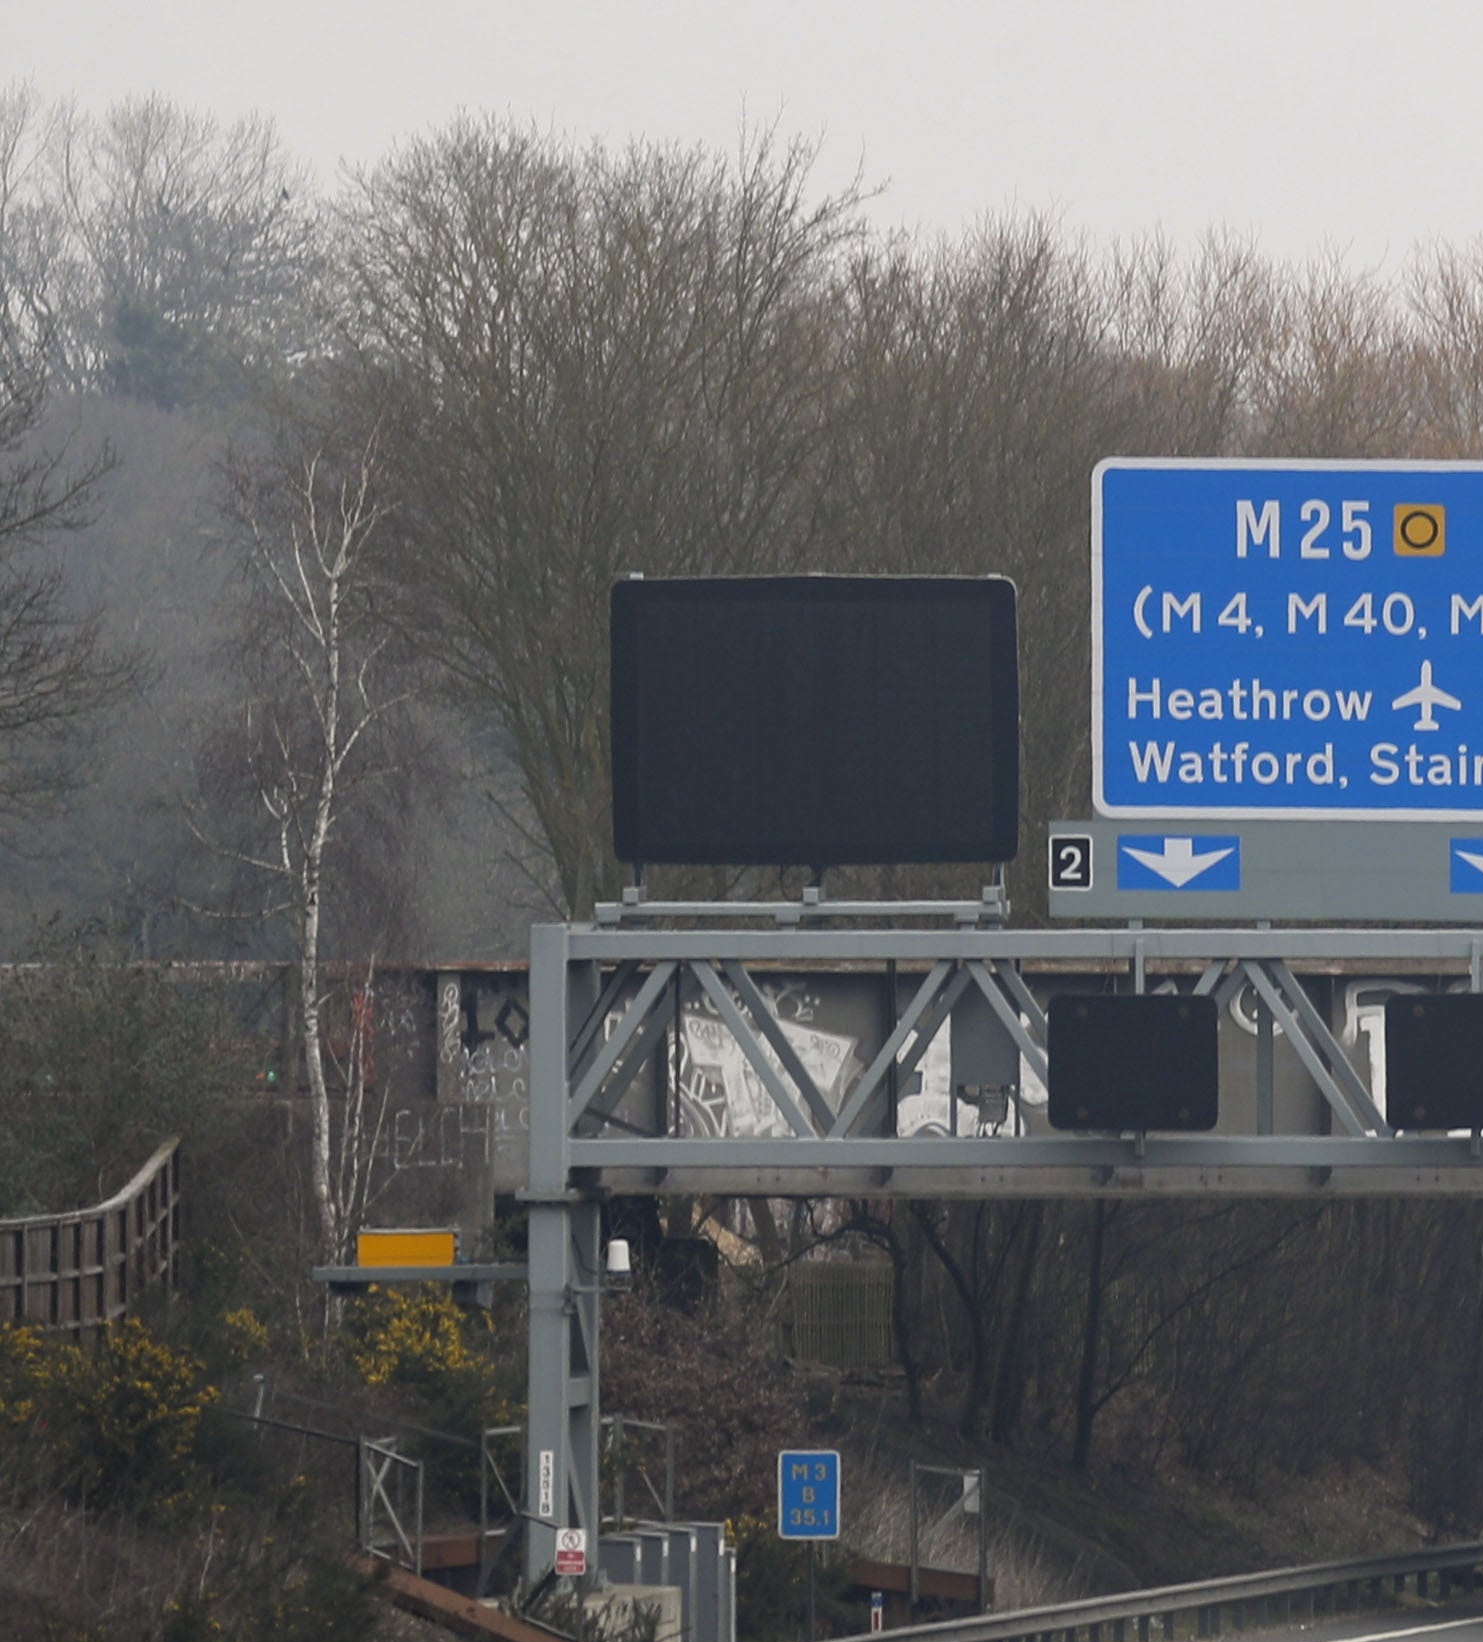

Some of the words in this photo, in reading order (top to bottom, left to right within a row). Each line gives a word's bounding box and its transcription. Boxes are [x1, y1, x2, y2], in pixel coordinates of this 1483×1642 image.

[1128, 677, 1373, 721] Heathrow
[1129, 741, 1348, 789] Watford,
[1060, 846, 1082, 880] 2
[790, 1509, 831, 1526] 35.1
